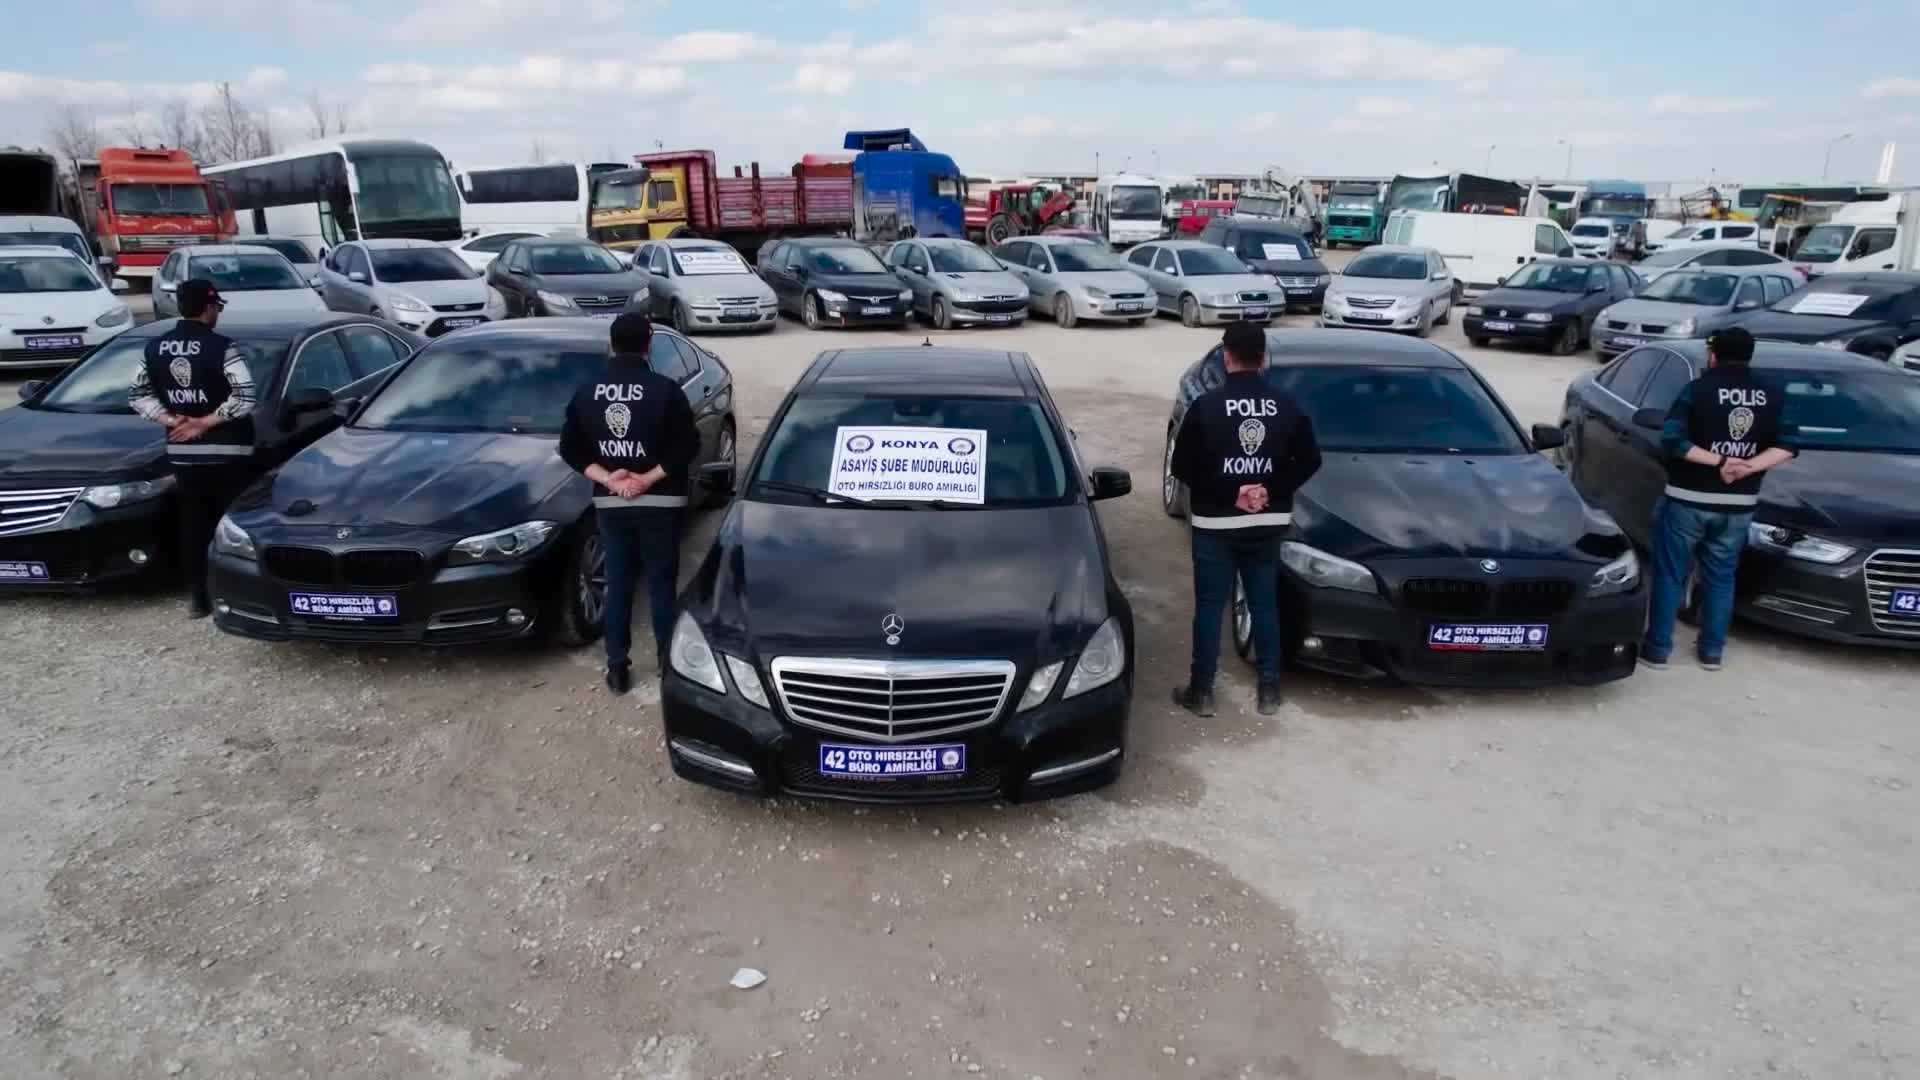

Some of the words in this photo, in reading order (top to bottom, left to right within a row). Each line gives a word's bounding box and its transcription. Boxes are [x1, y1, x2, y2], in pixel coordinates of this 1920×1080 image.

[159, 340, 200, 356] POLIS
[594, 383, 644, 402] POLIS
[1718, 388, 1767, 406] POLIS
[1225, 398, 1278, 417] POLIS
[598, 439, 647, 457] KONYA
[881, 440, 940, 450] KONYA
[1711, 441, 1757, 457] KONYA
[840, 456, 877, 474] ASAYİŞ
[880, 457, 909, 475] ŞUBE
[911, 456, 977, 475] MÜDÜRLÜĞÜ
[1223, 457, 1273, 474] KONYA
[837, 481, 856, 491] OTO
[909, 480, 934, 491] BÜRO
[294, 597, 310, 610] 42
[310, 596, 328, 605] OTO
[1897, 595, 1916, 609] 42
[1434, 628, 1452, 641] 42
[1455, 627, 1474, 635] OTO
[1454, 635, 1480, 643] BÜRO
[825, 750, 845, 769] 42
[848, 750, 872, 761] OTO
[875, 748, 937, 761] HIRSIZLIĞI
[848, 760, 881, 773] BÜRO
[884, 760, 937, 773] AMİRLİĞİ
